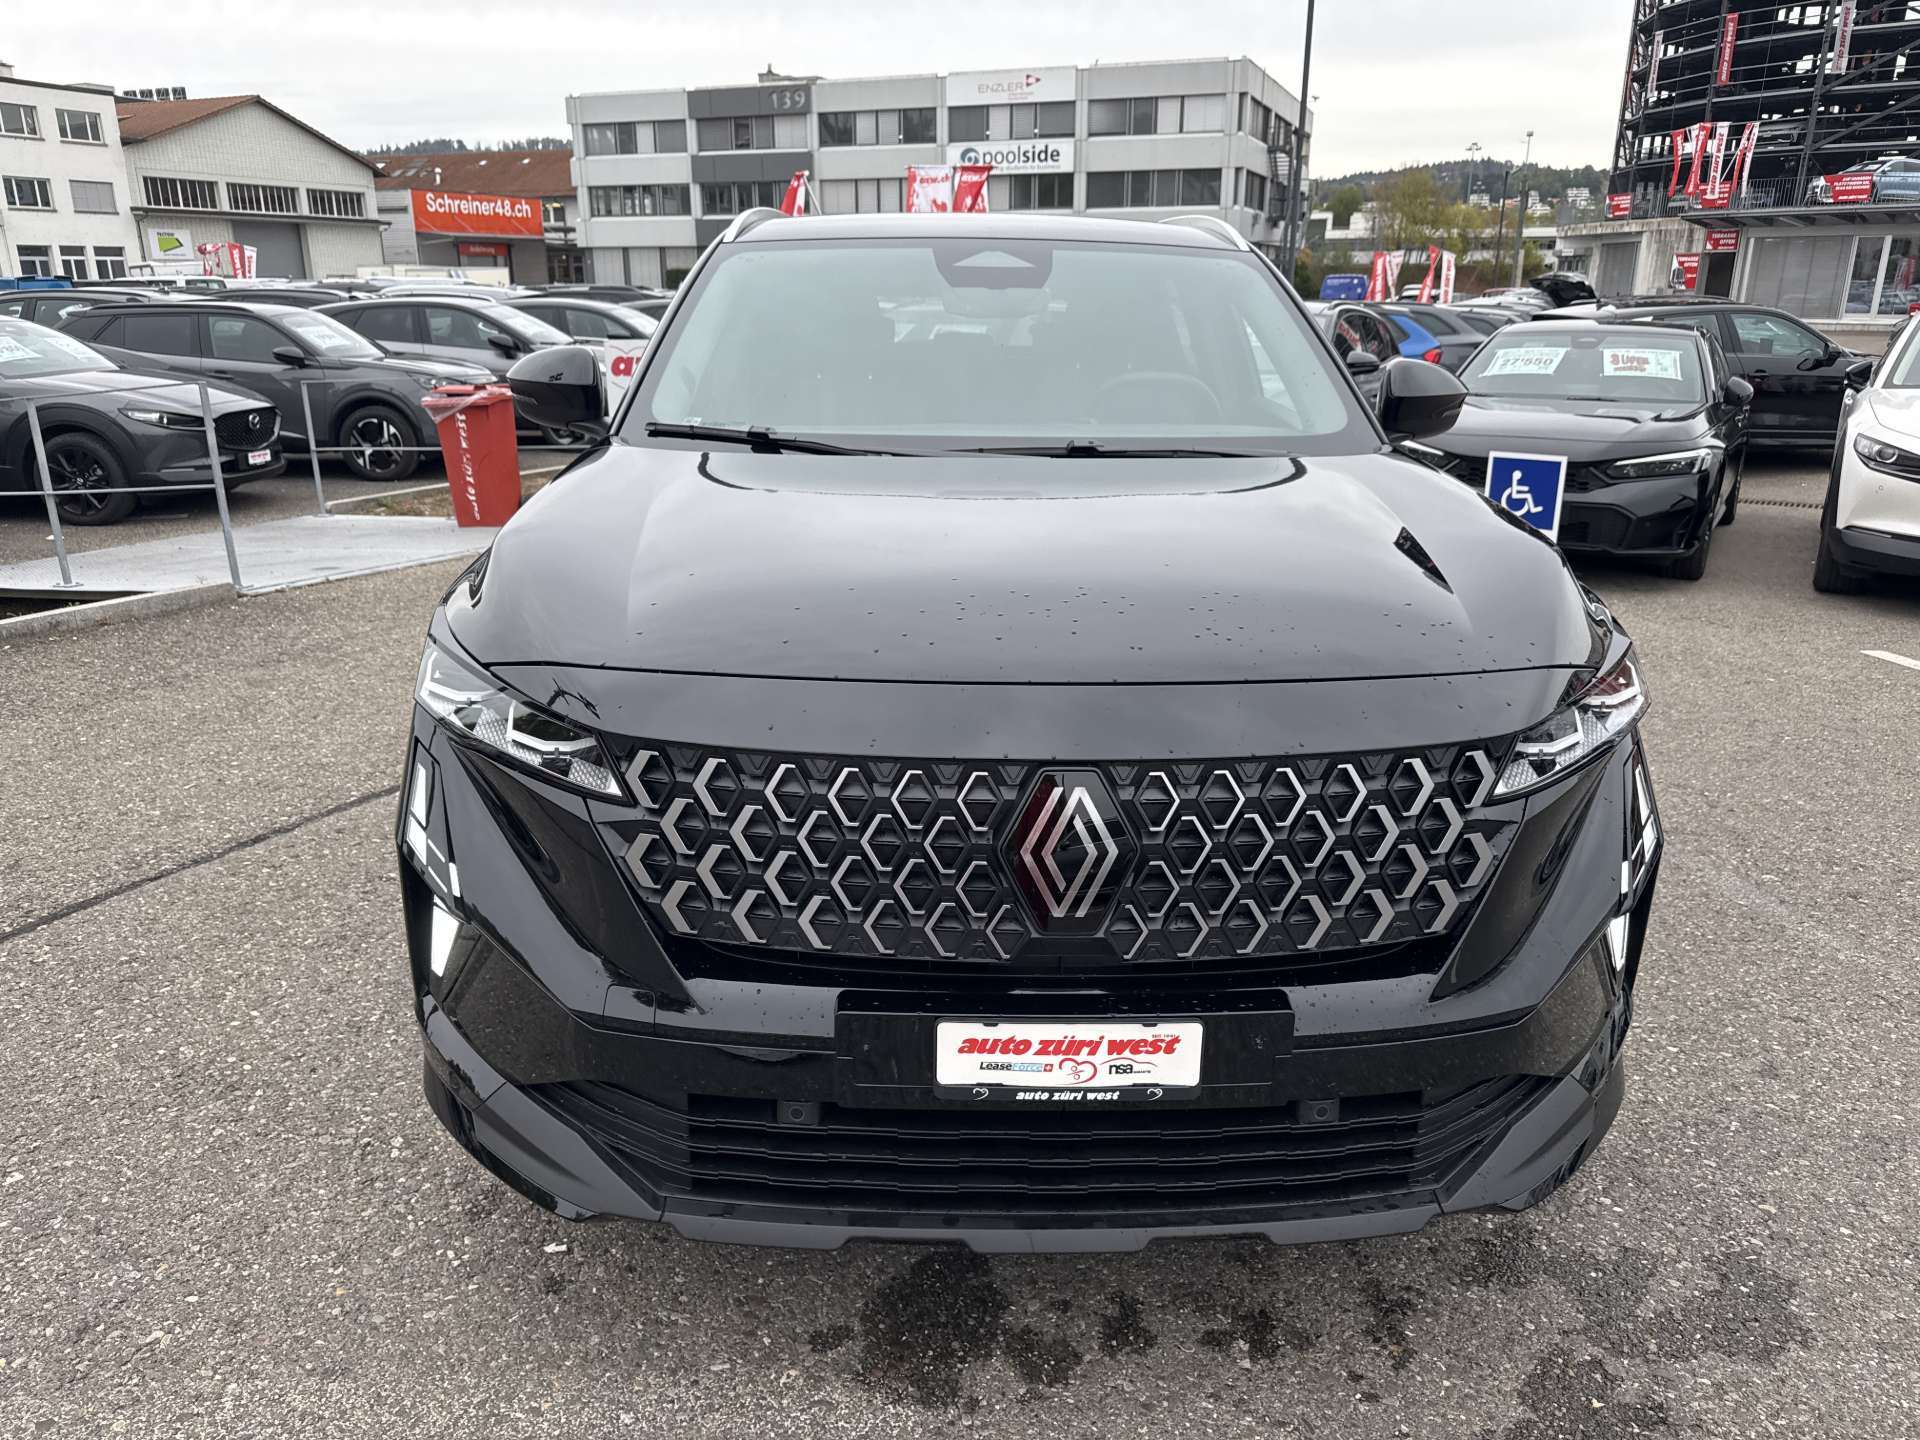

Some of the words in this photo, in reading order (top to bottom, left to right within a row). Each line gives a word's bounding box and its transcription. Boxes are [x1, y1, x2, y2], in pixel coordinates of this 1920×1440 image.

[977, 81, 1025, 94] ENZLER
[769, 89, 806, 109] 139
[984, 144, 1061, 165] poolside
[425, 192, 532, 218] Schreiner48.ch
[957, 1034, 1032, 1055] auto
[1032, 1035, 1105, 1056] züri
[1107, 1034, 1182, 1055] west
[979, 1061, 1043, 1072] LeaseForce
[1109, 1064, 1133, 1075] nsa
[1015, 1090, 1050, 1100] auto
[1051, 1090, 1084, 1100] züri
[1086, 1090, 1120, 1101] west
